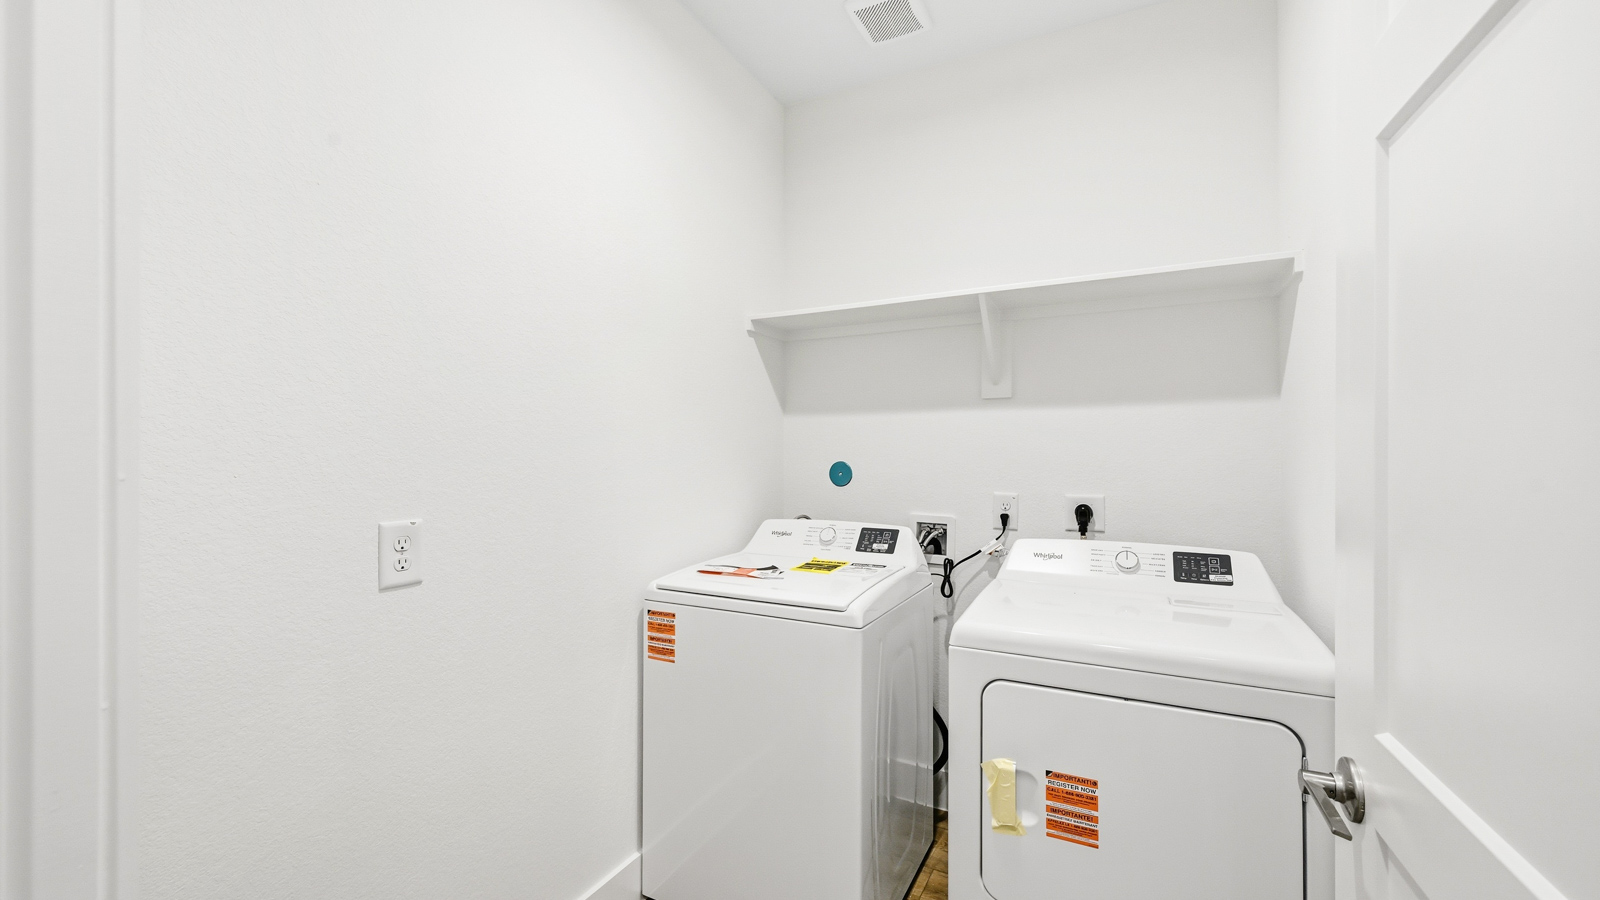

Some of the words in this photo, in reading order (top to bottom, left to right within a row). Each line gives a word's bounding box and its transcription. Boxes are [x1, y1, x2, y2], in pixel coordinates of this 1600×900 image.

[771, 530, 793, 538] Whirlpool
[1033, 552, 1063, 561] Whirlpool
[1046, 786, 1060, 794] CALL
[1047, 779, 1080, 791] REGISTER
[1080, 786, 1097, 795] NOW
